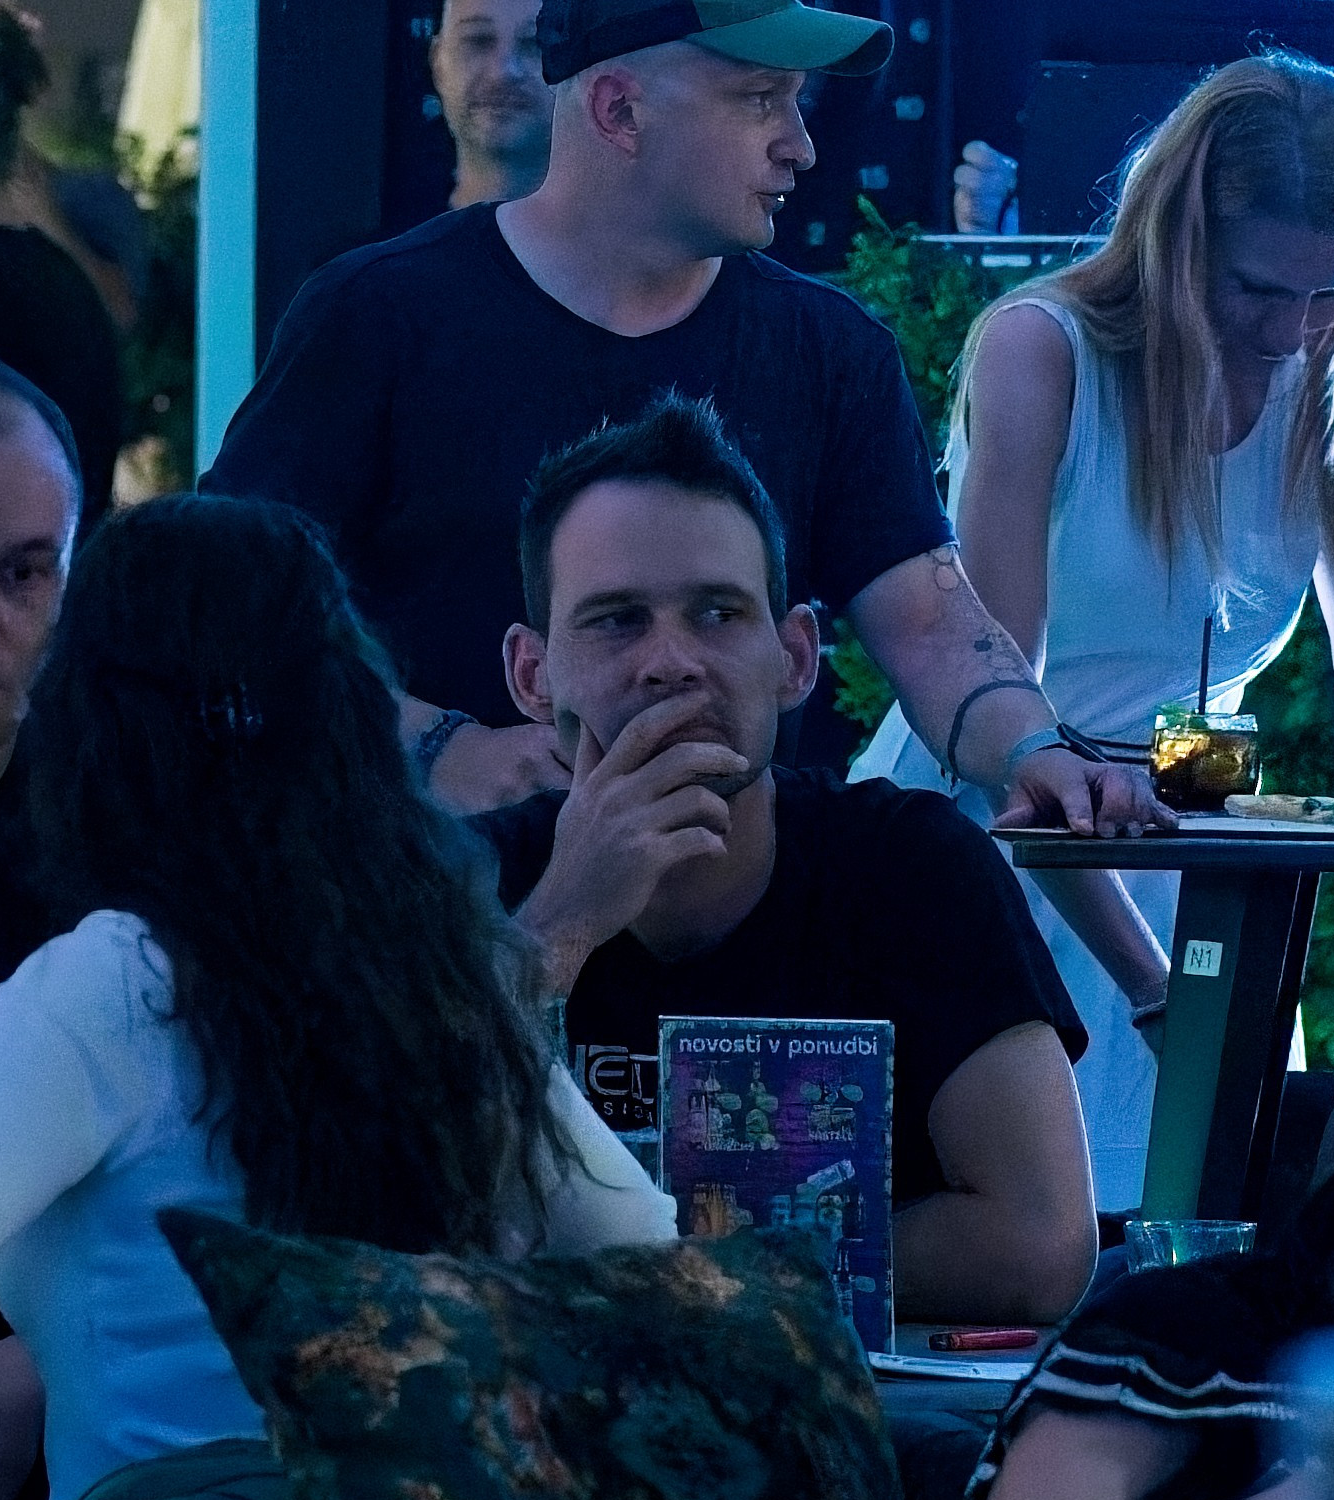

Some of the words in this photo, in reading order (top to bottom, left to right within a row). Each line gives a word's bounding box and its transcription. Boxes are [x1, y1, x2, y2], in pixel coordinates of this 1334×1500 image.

[679, 1033, 761, 1053] novosti
[768, 1039, 781, 1054] v
[788, 1034, 878, 1059] ponudbi
